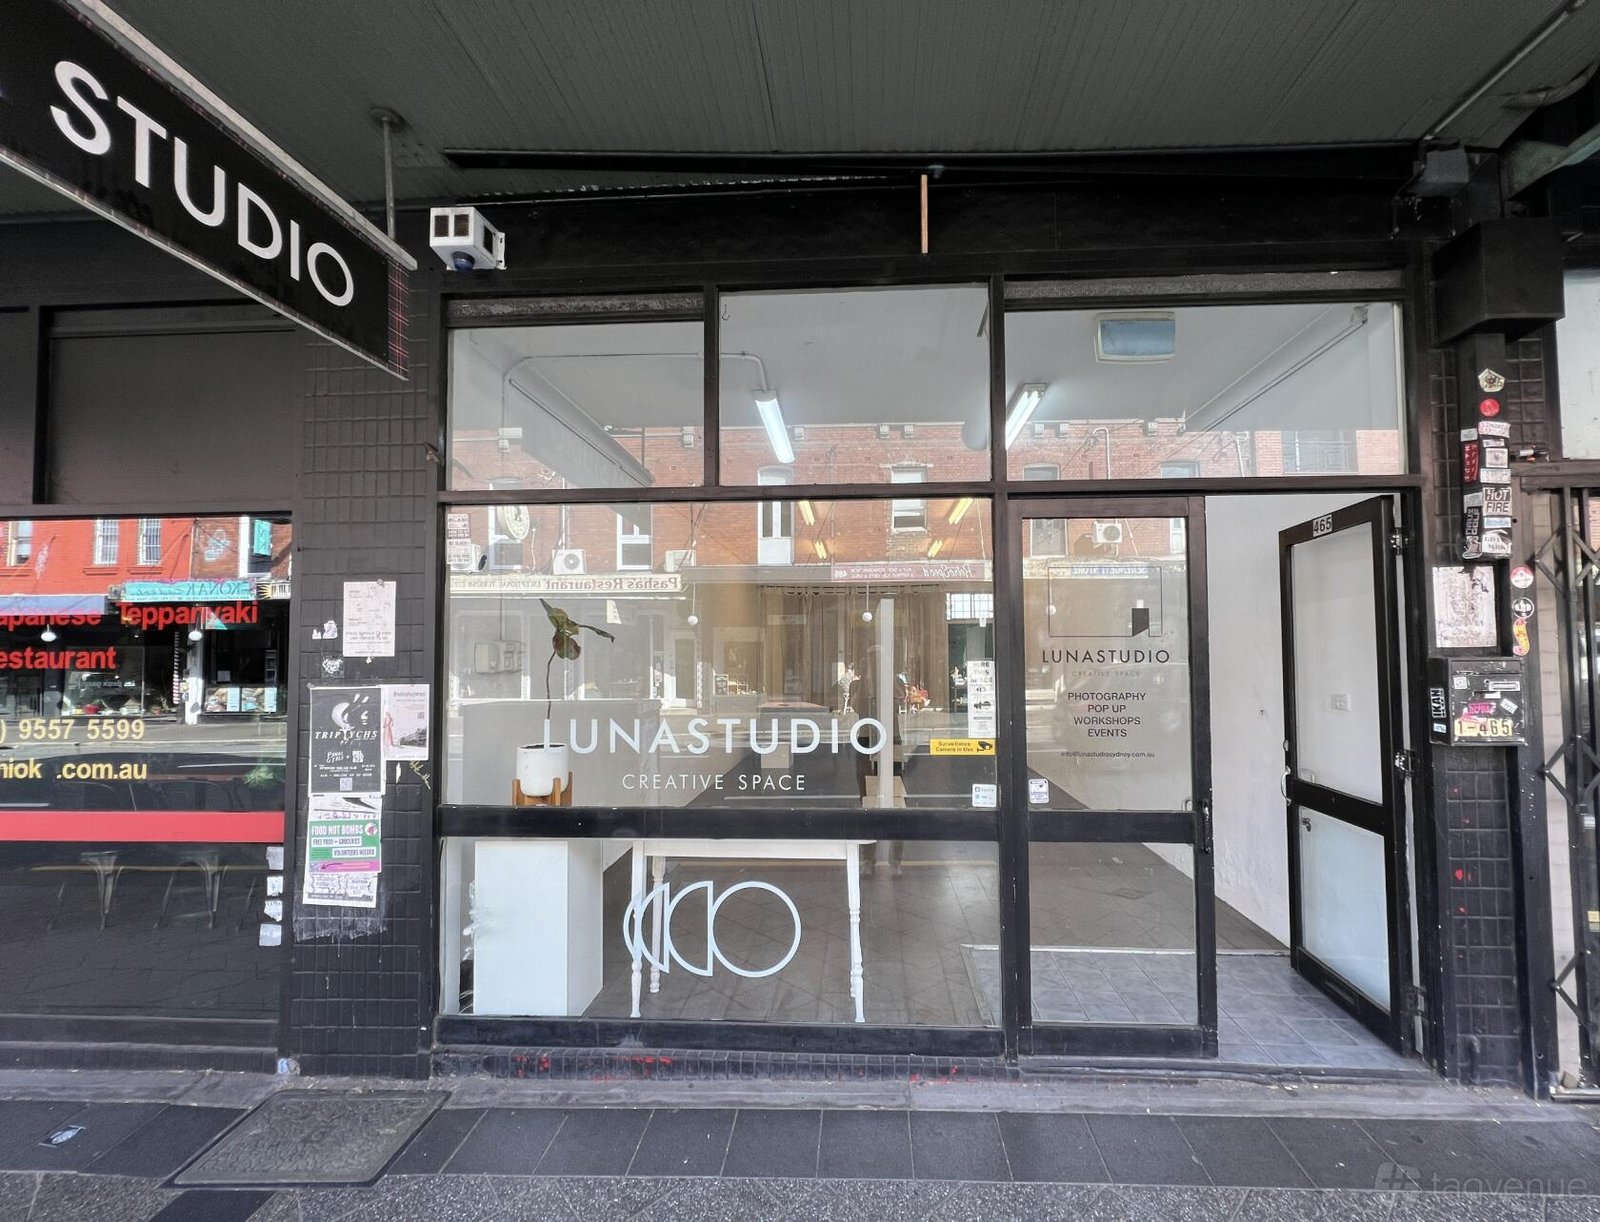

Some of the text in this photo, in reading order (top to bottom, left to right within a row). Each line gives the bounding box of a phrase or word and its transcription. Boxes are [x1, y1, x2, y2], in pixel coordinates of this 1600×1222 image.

[50, 60, 354, 307] STUDIO
[1486, 489, 1509, 501] HOT
[1487, 502, 1509, 513] FIRE
[1313, 516, 1332, 534] 465
[1042, 650, 1170, 663] LUNASTUDIO
[1067, 692, 1147, 701] PHOTOGRAPHY
[1087, 704, 1126, 713] POP UP
[1431, 689, 1442, 717] IKAN
[1073, 716, 1141, 725] WORKSHOPS
[18, 719, 74, 739] 9557
[87, 719, 146, 740] 5599
[1087, 728, 1128, 737] EVENTS
[56, 760, 147, 779] .com.au
[621, 773, 805, 791] CREATIVE SPACE
[311, 825, 328, 836] FOOD
[328, 825, 341, 836] NOT
